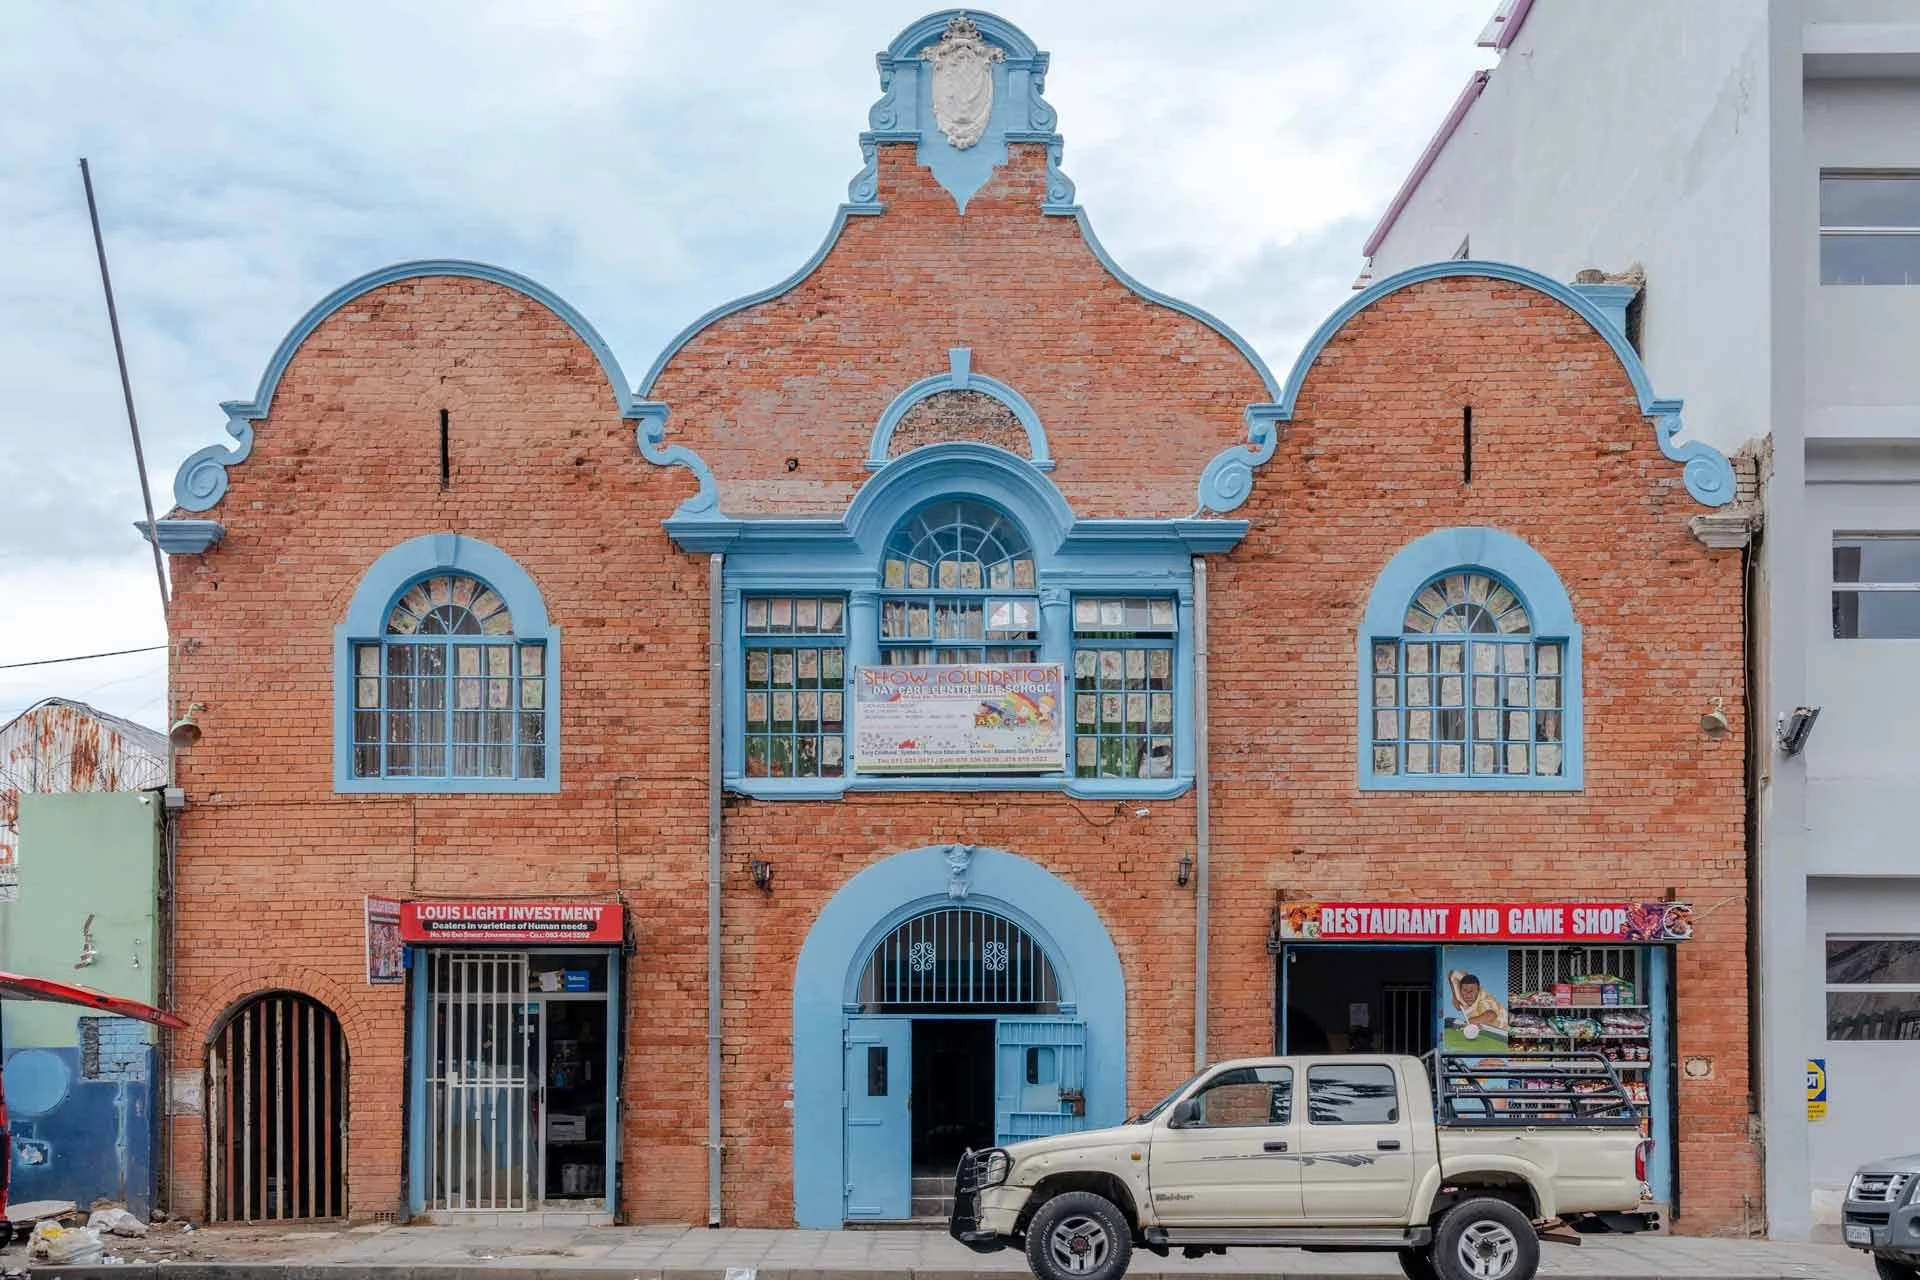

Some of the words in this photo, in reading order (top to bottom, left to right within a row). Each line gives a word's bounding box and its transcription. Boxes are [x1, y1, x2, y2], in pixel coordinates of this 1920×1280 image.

[863, 670, 928, 685] SHOW
[936, 668, 1060, 685] FOUNDATION
[873, 686, 894, 696] DAY
[930, 684, 977, 696] CENTRE
[416, 906, 461, 920] LOUIS
[463, 906, 507, 920] LIGHT
[508, 906, 604, 920] INVESTMENT
[432, 922, 467, 930] Dealers
[477, 922, 517, 930] varieties
[517, 922, 527, 930] of
[527, 922, 560, 930] Human
[560, 922, 588, 930] needs
[1321, 908, 1449, 934] RESTAURANT
[1458, 908, 1499, 934] AND
[1508, 908, 1564, 934] GAME
[1572, 908, 1627, 934] SHOP
